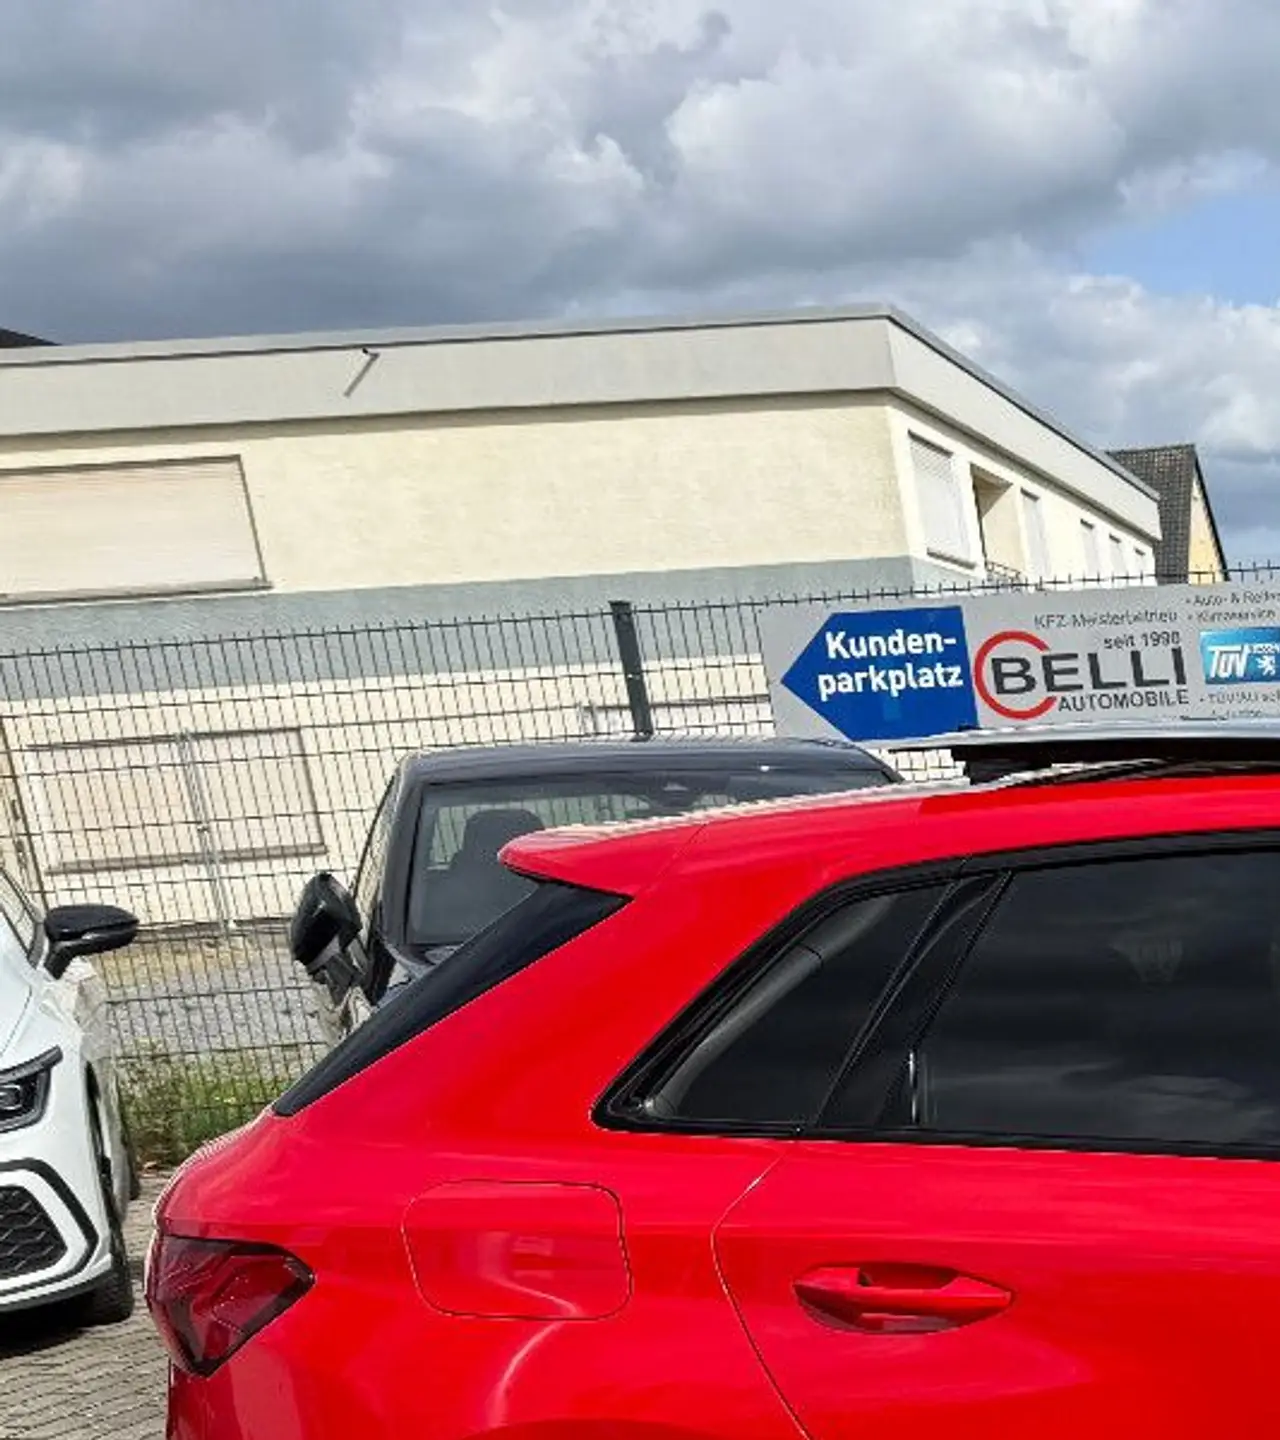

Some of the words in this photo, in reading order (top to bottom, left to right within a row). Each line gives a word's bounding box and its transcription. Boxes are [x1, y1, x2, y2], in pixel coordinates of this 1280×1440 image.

[825, 629, 957, 659] Kunden-
[1103, 634, 1135, 649] seit
[818, 662, 964, 702] parkplatz
[991, 646, 1187, 695] BELLI
[1058, 689, 1190, 712] AUTOMOBILE
